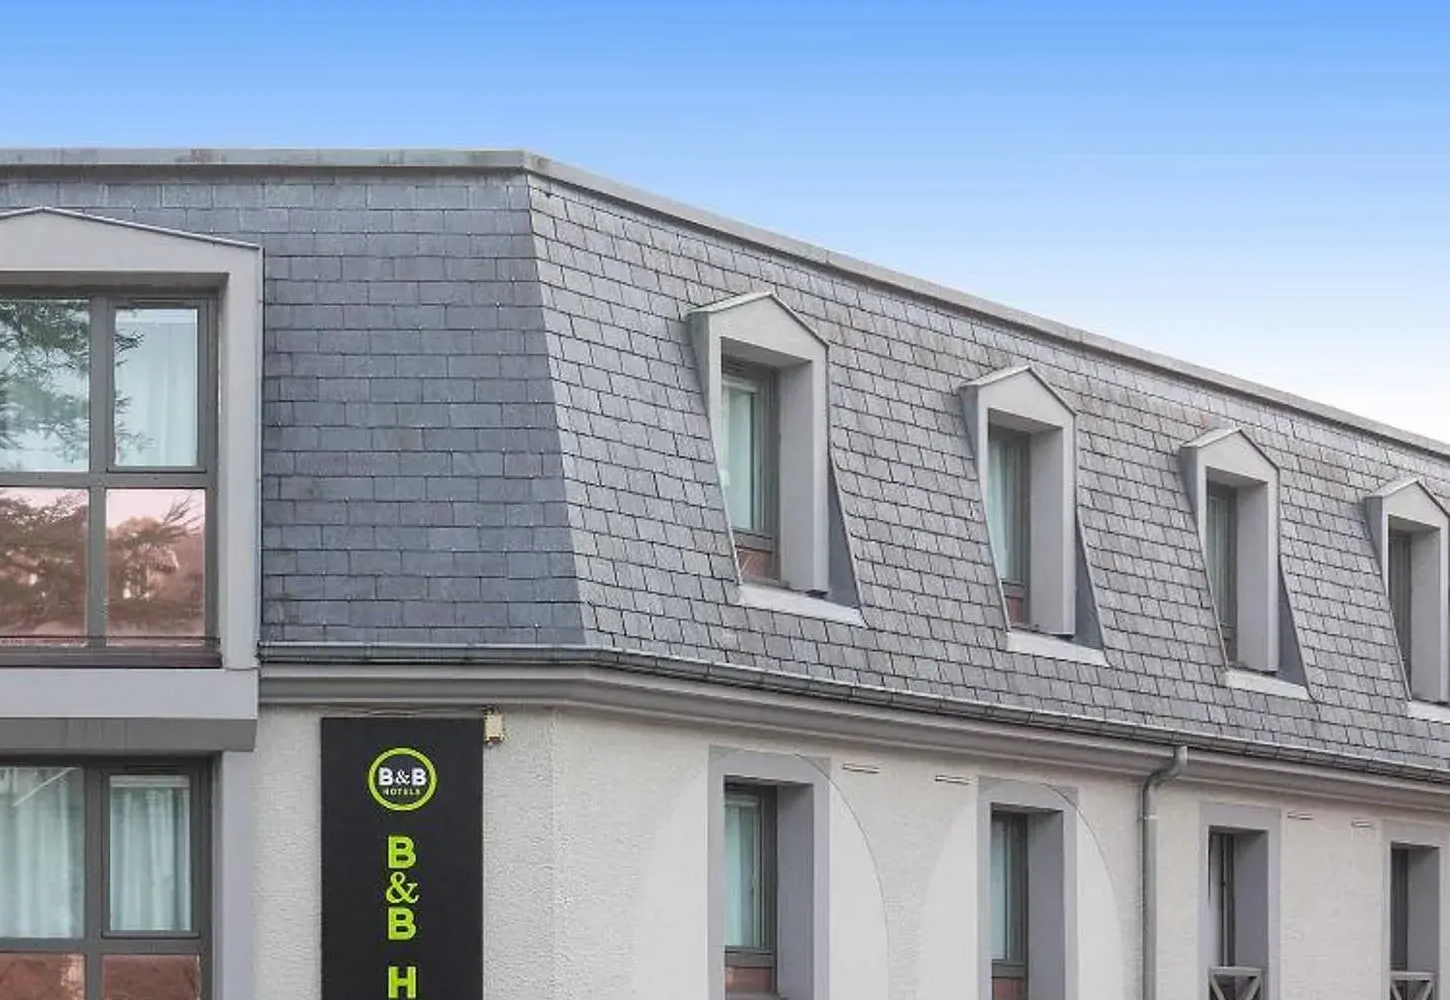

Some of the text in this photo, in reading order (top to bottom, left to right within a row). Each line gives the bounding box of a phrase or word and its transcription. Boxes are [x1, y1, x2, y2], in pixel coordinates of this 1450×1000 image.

[378, 767, 427, 786] B&B
[383, 787, 421, 796] HOTELS
[385, 835, 419, 940] B&B
